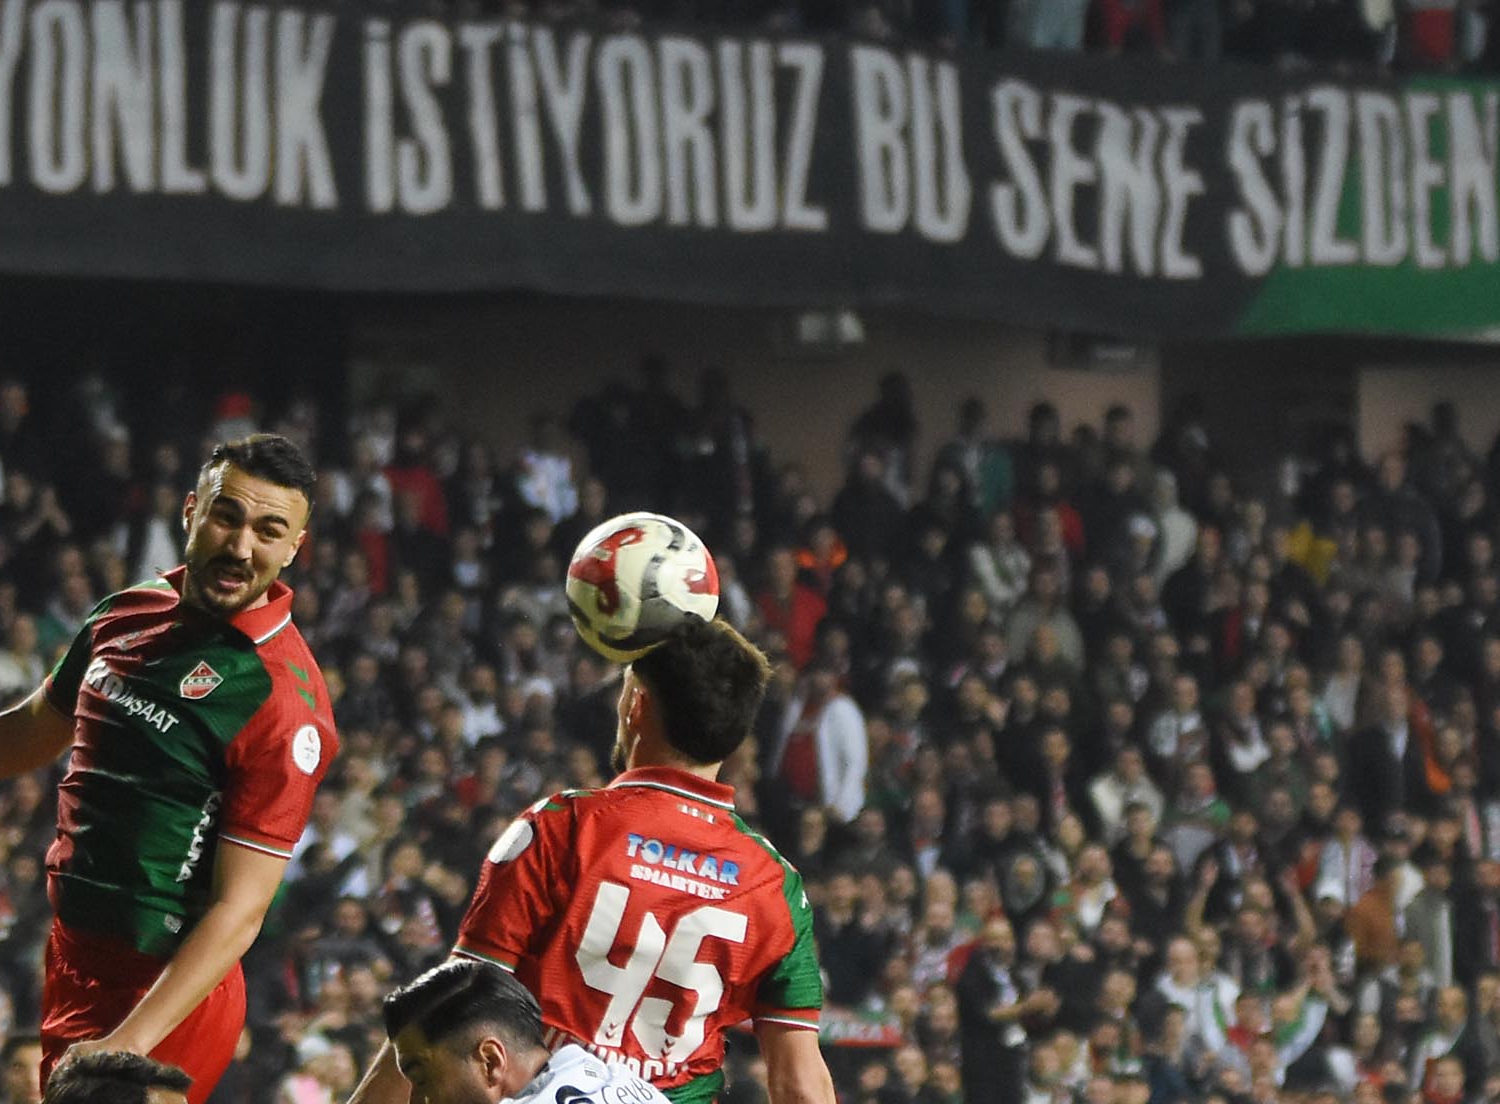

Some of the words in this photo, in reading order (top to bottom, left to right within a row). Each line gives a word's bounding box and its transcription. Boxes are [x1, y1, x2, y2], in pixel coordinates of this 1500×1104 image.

[364, 20, 828, 231] İSTİYORUZ
[852, 47, 971, 243] BU
[990, 77, 1204, 280] SENE
[1228, 84, 1500, 277] SİZDEN
[626, 832, 740, 887] TOLKAR
[575, 880, 748, 1063] 45
